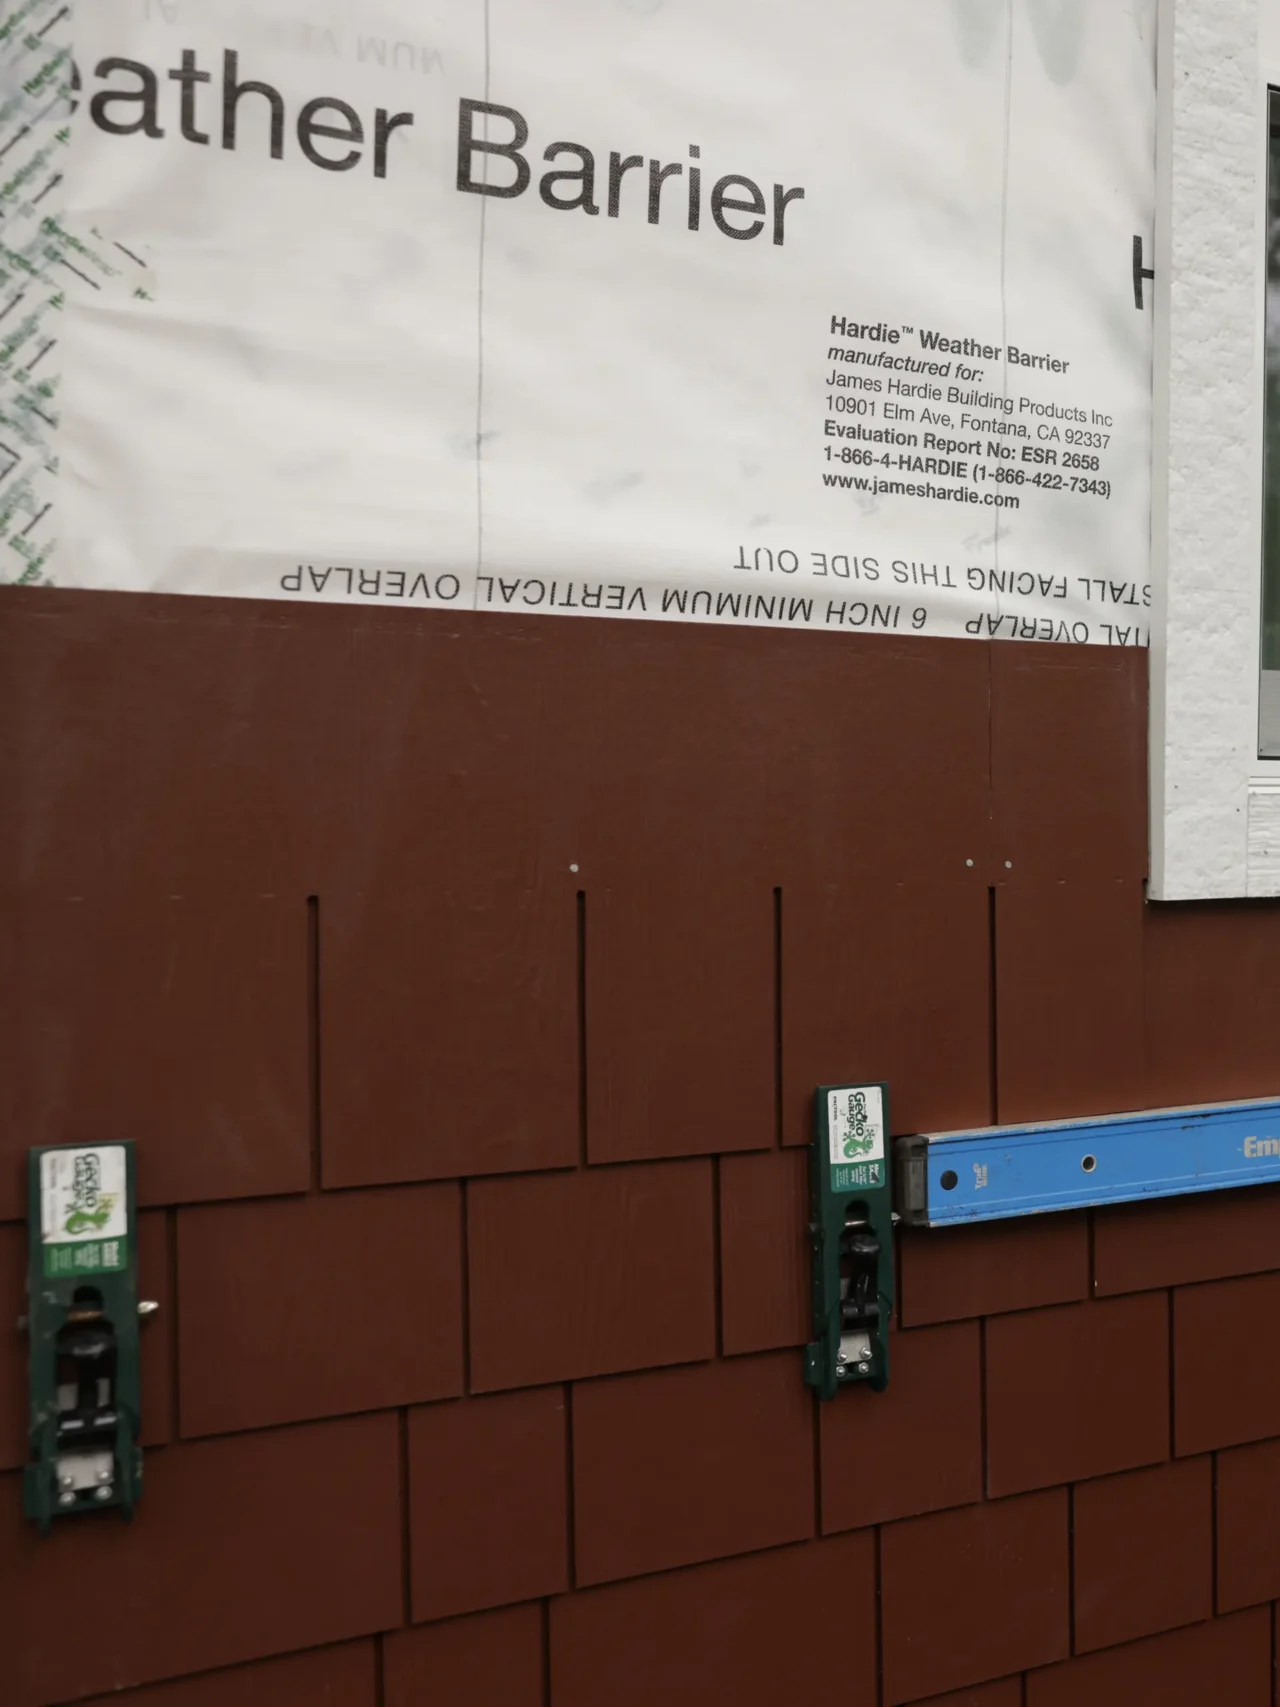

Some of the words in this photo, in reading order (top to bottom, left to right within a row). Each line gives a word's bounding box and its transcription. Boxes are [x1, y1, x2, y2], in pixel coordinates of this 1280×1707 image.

[71, 48, 414, 179] ather
[456, 97, 805, 246] Barrier
[827, 347, 950, 377] manufactured
[954, 360, 985, 382] for:
[919, 329, 1003, 361] Weather
[1007, 346, 1070, 374] Barrier
[826, 370, 882, 393] James
[887, 378, 942, 401] Hardie
[947, 387, 1014, 415] Building
[1019, 397, 1087, 423] Products
[1091, 409, 1113, 428] Inc
[826, 395, 877, 417] 10901
[883, 402, 915, 422] Elm
[919, 408, 955, 430] Ave,
[960, 414, 1031, 440] Fontana,
[1037, 424, 1060, 443] CA
[1065, 430, 1111, 450] 92337
[824, 419, 918, 447] Evaluation
[923, 433, 982, 457] Report
[987, 442, 1016, 461] No:
[1021, 446, 1057, 466] ESR
[1062, 453, 1100, 472] 2658
[824, 445, 968, 479] 1-866-4-HARDIE
[973, 463, 1111, 500] (1-866-422-7343)
[822, 472, 1020, 509] www.jameshardie.com
[733, 545, 799, 574] OUT
[813, 552, 880, 581] SIDE
[893, 559, 958, 588] THIS
[281, 565, 460, 600] OVERLAP
[477, 576, 647, 611] VERTICAL
[967, 567, 1068, 599] FACING
[662, 588, 813, 622] MINIMUM
[826, 601, 898, 628] INCH
[911, 608, 928, 629] 6
[965, 613, 1090, 645] OVERLAP
[847, 1094, 856, 1131] Gauge
[855, 1092, 868, 1136] Gecko
